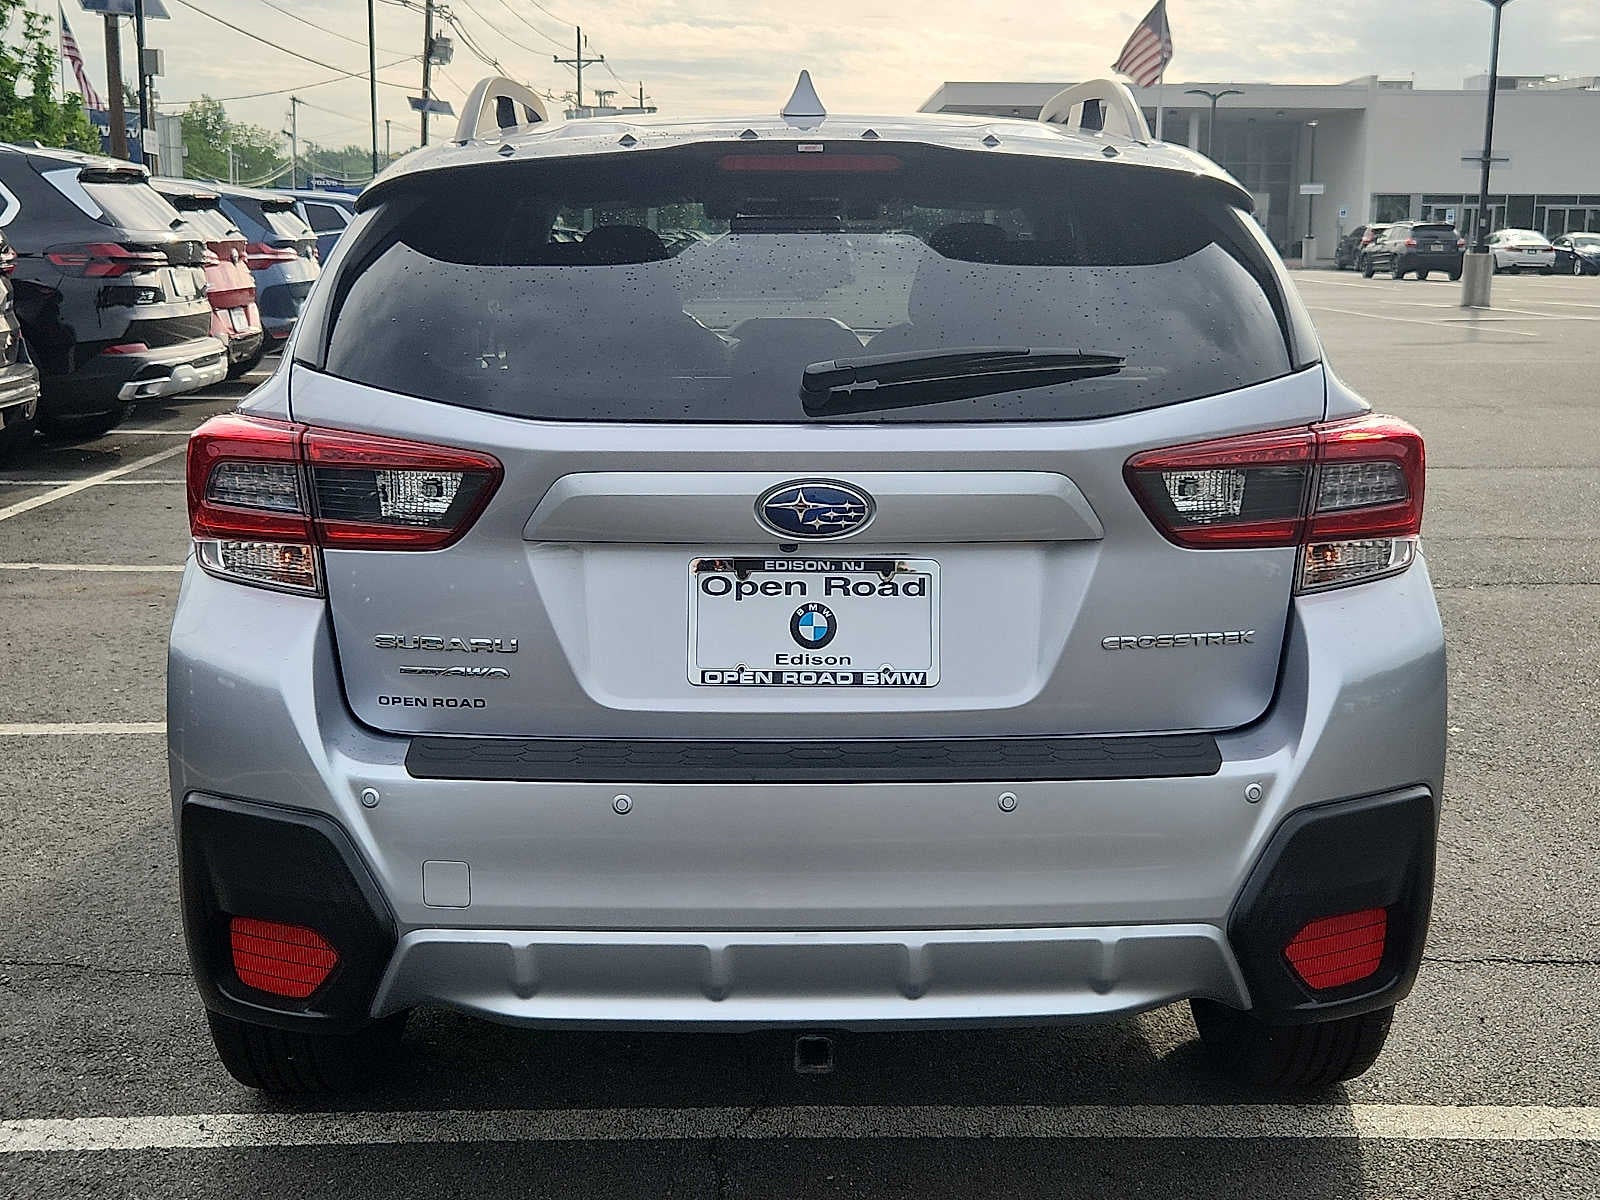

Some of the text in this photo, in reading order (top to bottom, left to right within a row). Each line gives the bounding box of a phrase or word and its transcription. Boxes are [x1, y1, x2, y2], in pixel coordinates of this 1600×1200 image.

[764, 560, 865, 571] EDISON, NJ
[701, 576, 926, 601] Open Road
[796, 603, 832, 618] BMW
[374, 634, 519, 653] SUBARU
[1101, 630, 1256, 650] CROSSTREK
[775, 653, 851, 666] Edison
[441, 666, 511, 678] AWD
[704, 671, 924, 684] OPEN ROAD BMW
[378, 695, 486, 708] OPEN ROAD
